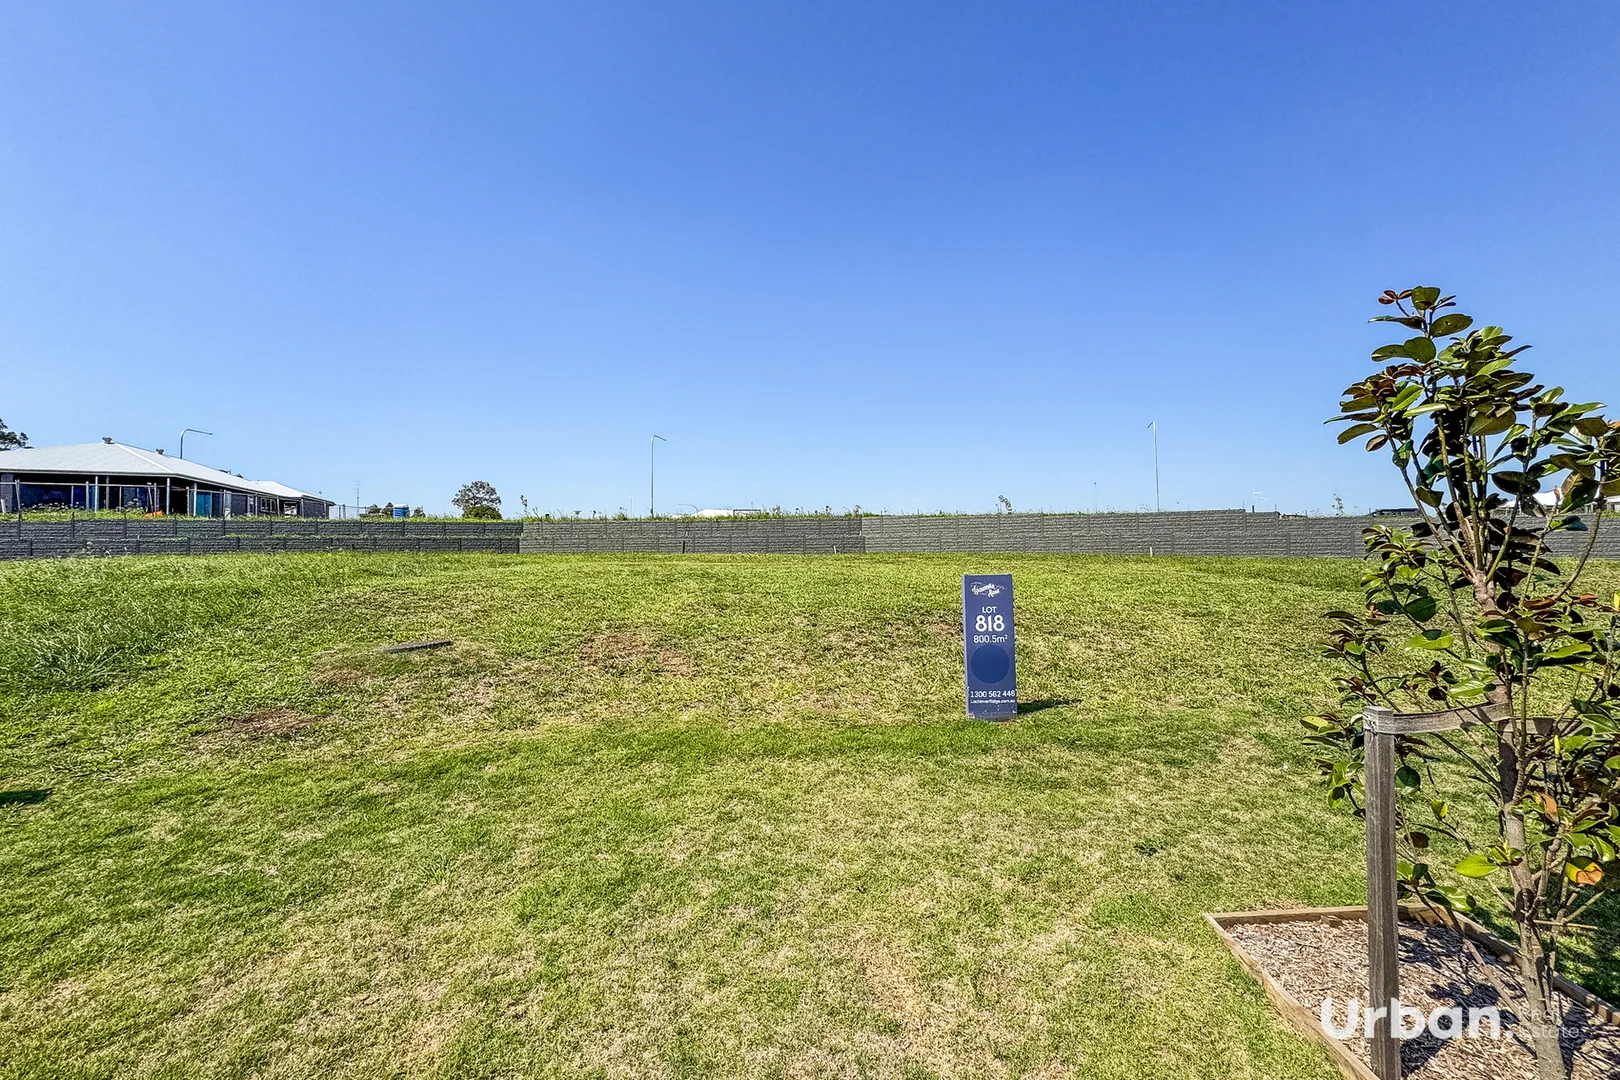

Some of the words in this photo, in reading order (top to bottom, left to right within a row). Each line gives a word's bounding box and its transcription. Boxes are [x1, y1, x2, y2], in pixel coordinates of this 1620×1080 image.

[975, 615, 1005, 632] 818
[970, 690, 987, 698] 1300
[988, 690, 1001, 698] 562
